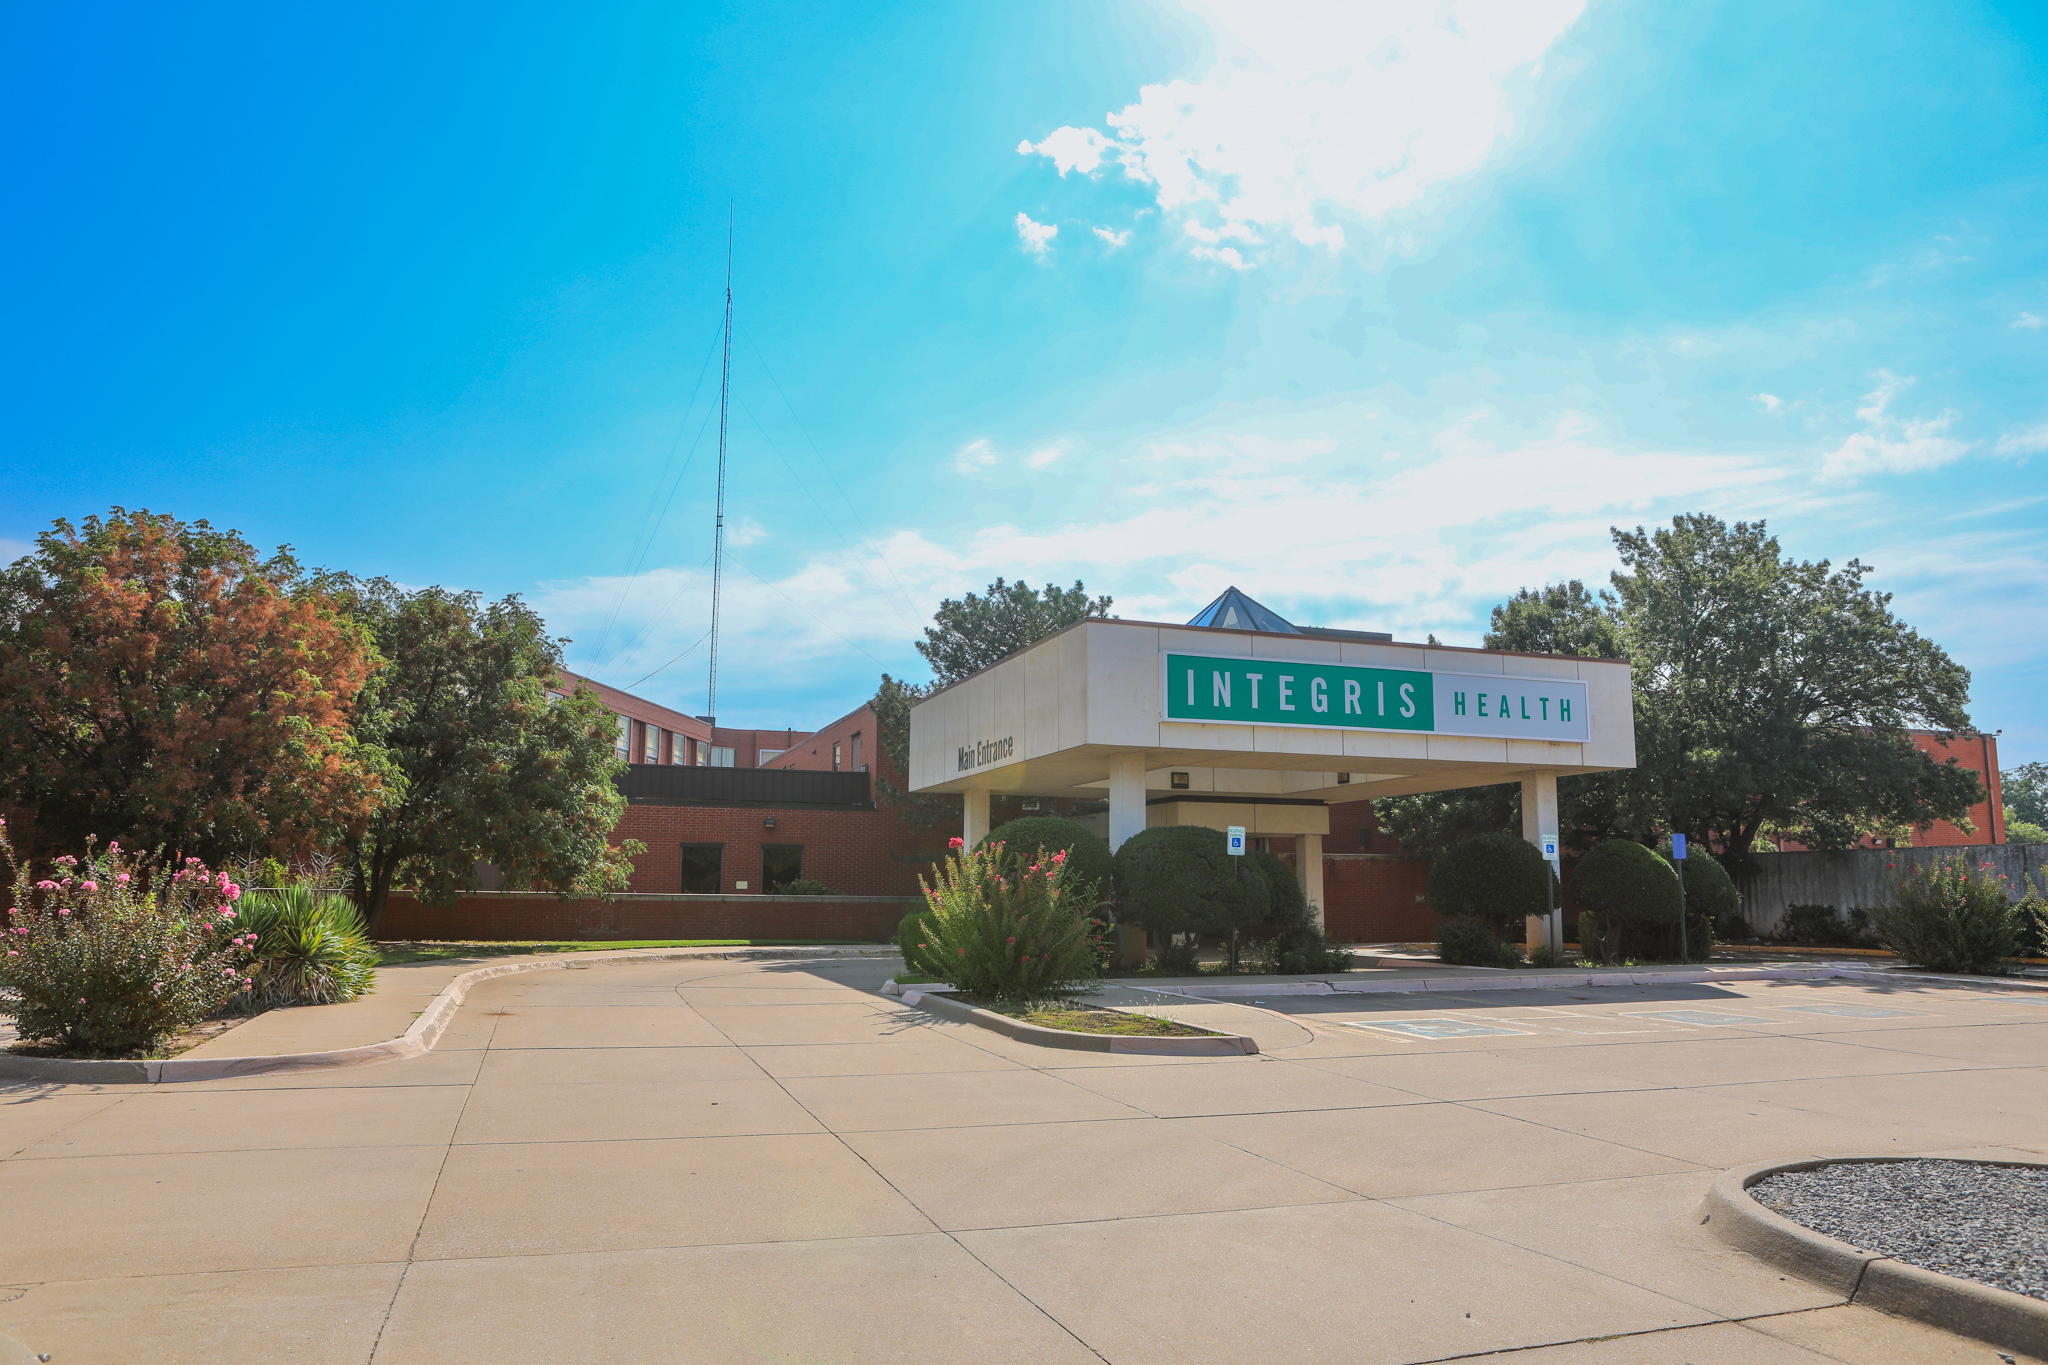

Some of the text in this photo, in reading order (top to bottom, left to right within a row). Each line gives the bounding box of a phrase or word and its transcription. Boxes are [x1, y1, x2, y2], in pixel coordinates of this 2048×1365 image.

[1187, 669, 1571, 722] INTEGRIS HEALTH
[958, 736, 1014, 772] Main Entrance
